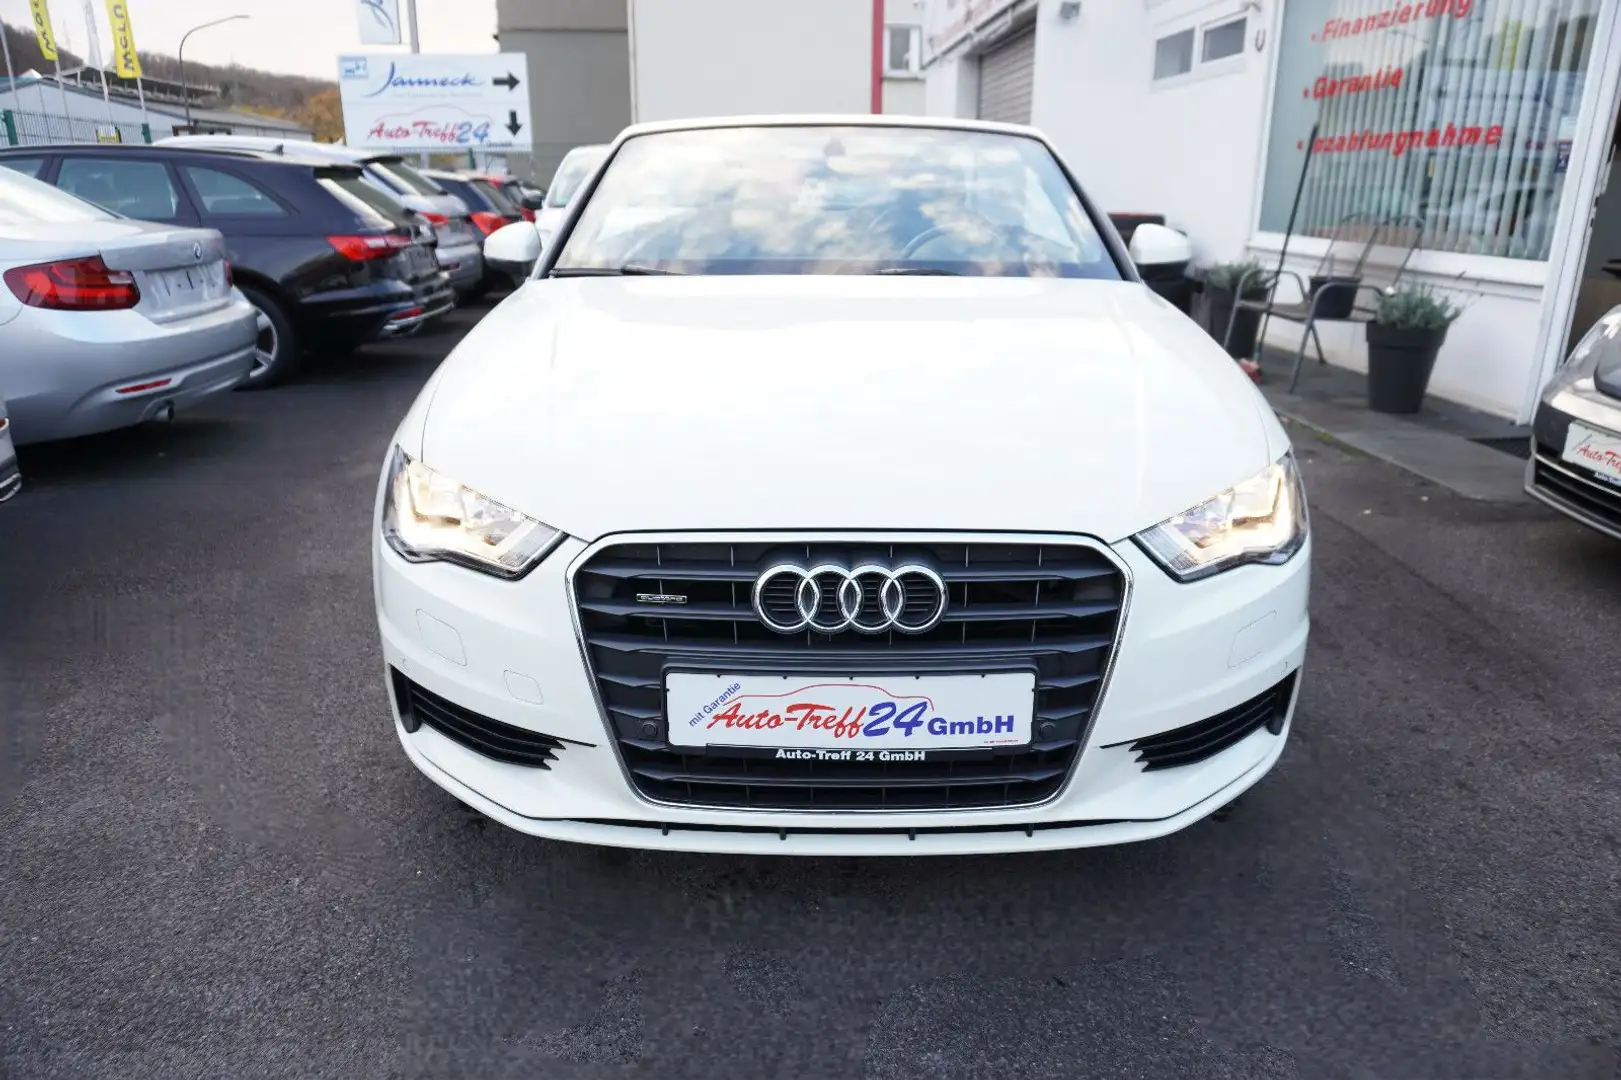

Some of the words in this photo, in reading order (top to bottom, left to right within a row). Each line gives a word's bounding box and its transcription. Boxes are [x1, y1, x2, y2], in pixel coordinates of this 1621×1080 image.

[1321, 0, 1474, 42] Finanzierung
[1313, 64, 1405, 99] Garantie
[1308, 121, 1504, 157] nzahlungnahme
[688, 712, 704, 728] mit
[702, 681, 742, 714] Garantie
[927, 715, 1015, 736] GmbH
[775, 748, 851, 761] Auto-Treff
[855, 751, 875, 762] 24
[878, 750, 926, 762] GmbH
